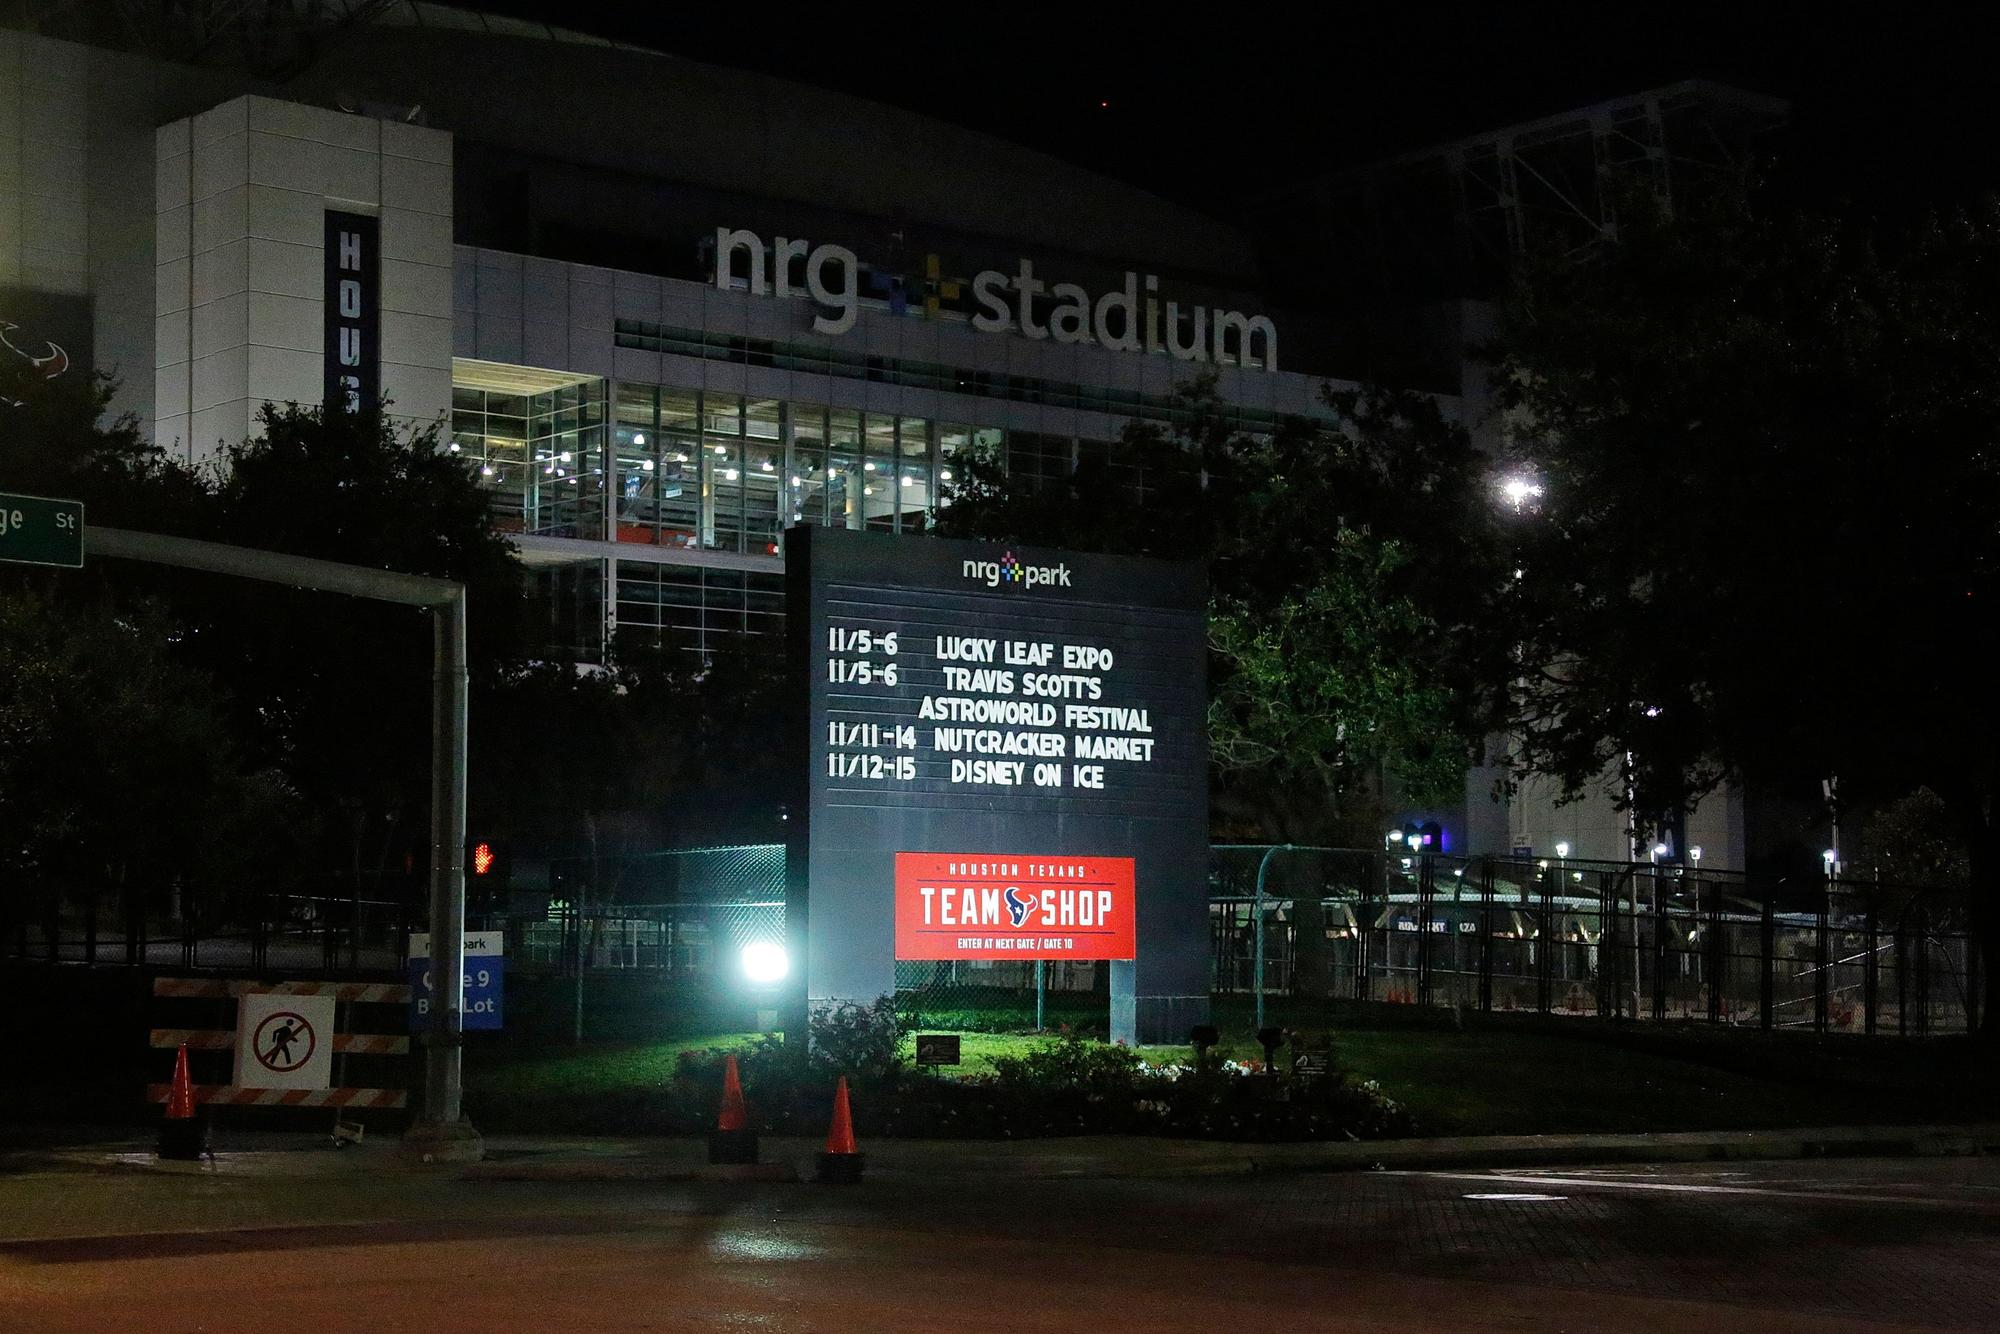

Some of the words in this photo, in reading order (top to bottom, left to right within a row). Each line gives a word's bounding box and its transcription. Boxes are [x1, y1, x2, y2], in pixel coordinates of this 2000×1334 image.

[717, 226, 858, 335] nrg
[972, 258, 1277, 372] stadium
[56, 512, 75, 529] St
[963, 560, 1000, 587] nrg
[1025, 562, 1071, 589] park
[829, 627, 898, 655] 11/5-6
[936, 635, 997, 662] LUCKY
[1004, 641, 1054, 667] LEAF
[1063, 645, 1113, 671] EXPO
[829, 658, 898, 687] 11/5-6
[942, 666, 1015, 694] TRAVIS
[1022, 673, 1102, 700] SCOTT'S
[918, 695, 1057, 727] ASTROWORLD
[1065, 704, 1153, 732] FESTIVAL
[829, 721, 917, 750] 11/11-14
[934, 727, 1066, 757] NUTCRACKER
[1074, 735, 1155, 762] MARKET
[828, 752, 916, 780] 11/12-15
[951, 759, 1025, 786] DISNEY
[1033, 763, 1062, 787] ON
[1073, 764, 1105, 789] ICE
[949, 863, 1018, 877] HOUSTON
[1029, 865, 1084, 878] TEXANS
[920, 887, 1000, 926] TEAM
[1041, 889, 1112, 926] SHOP
[957, 938, 982, 949] ENTER
[984, 938, 993, 949] AT
[995, 938, 1015, 949] NEXT
[1017, 938, 1035, 949] GATE
[1044, 938, 1062, 949] GATE
[1064, 938, 1073, 949] 10
[477, 970, 490, 988] 9
[463, 998, 495, 1014] Lot
